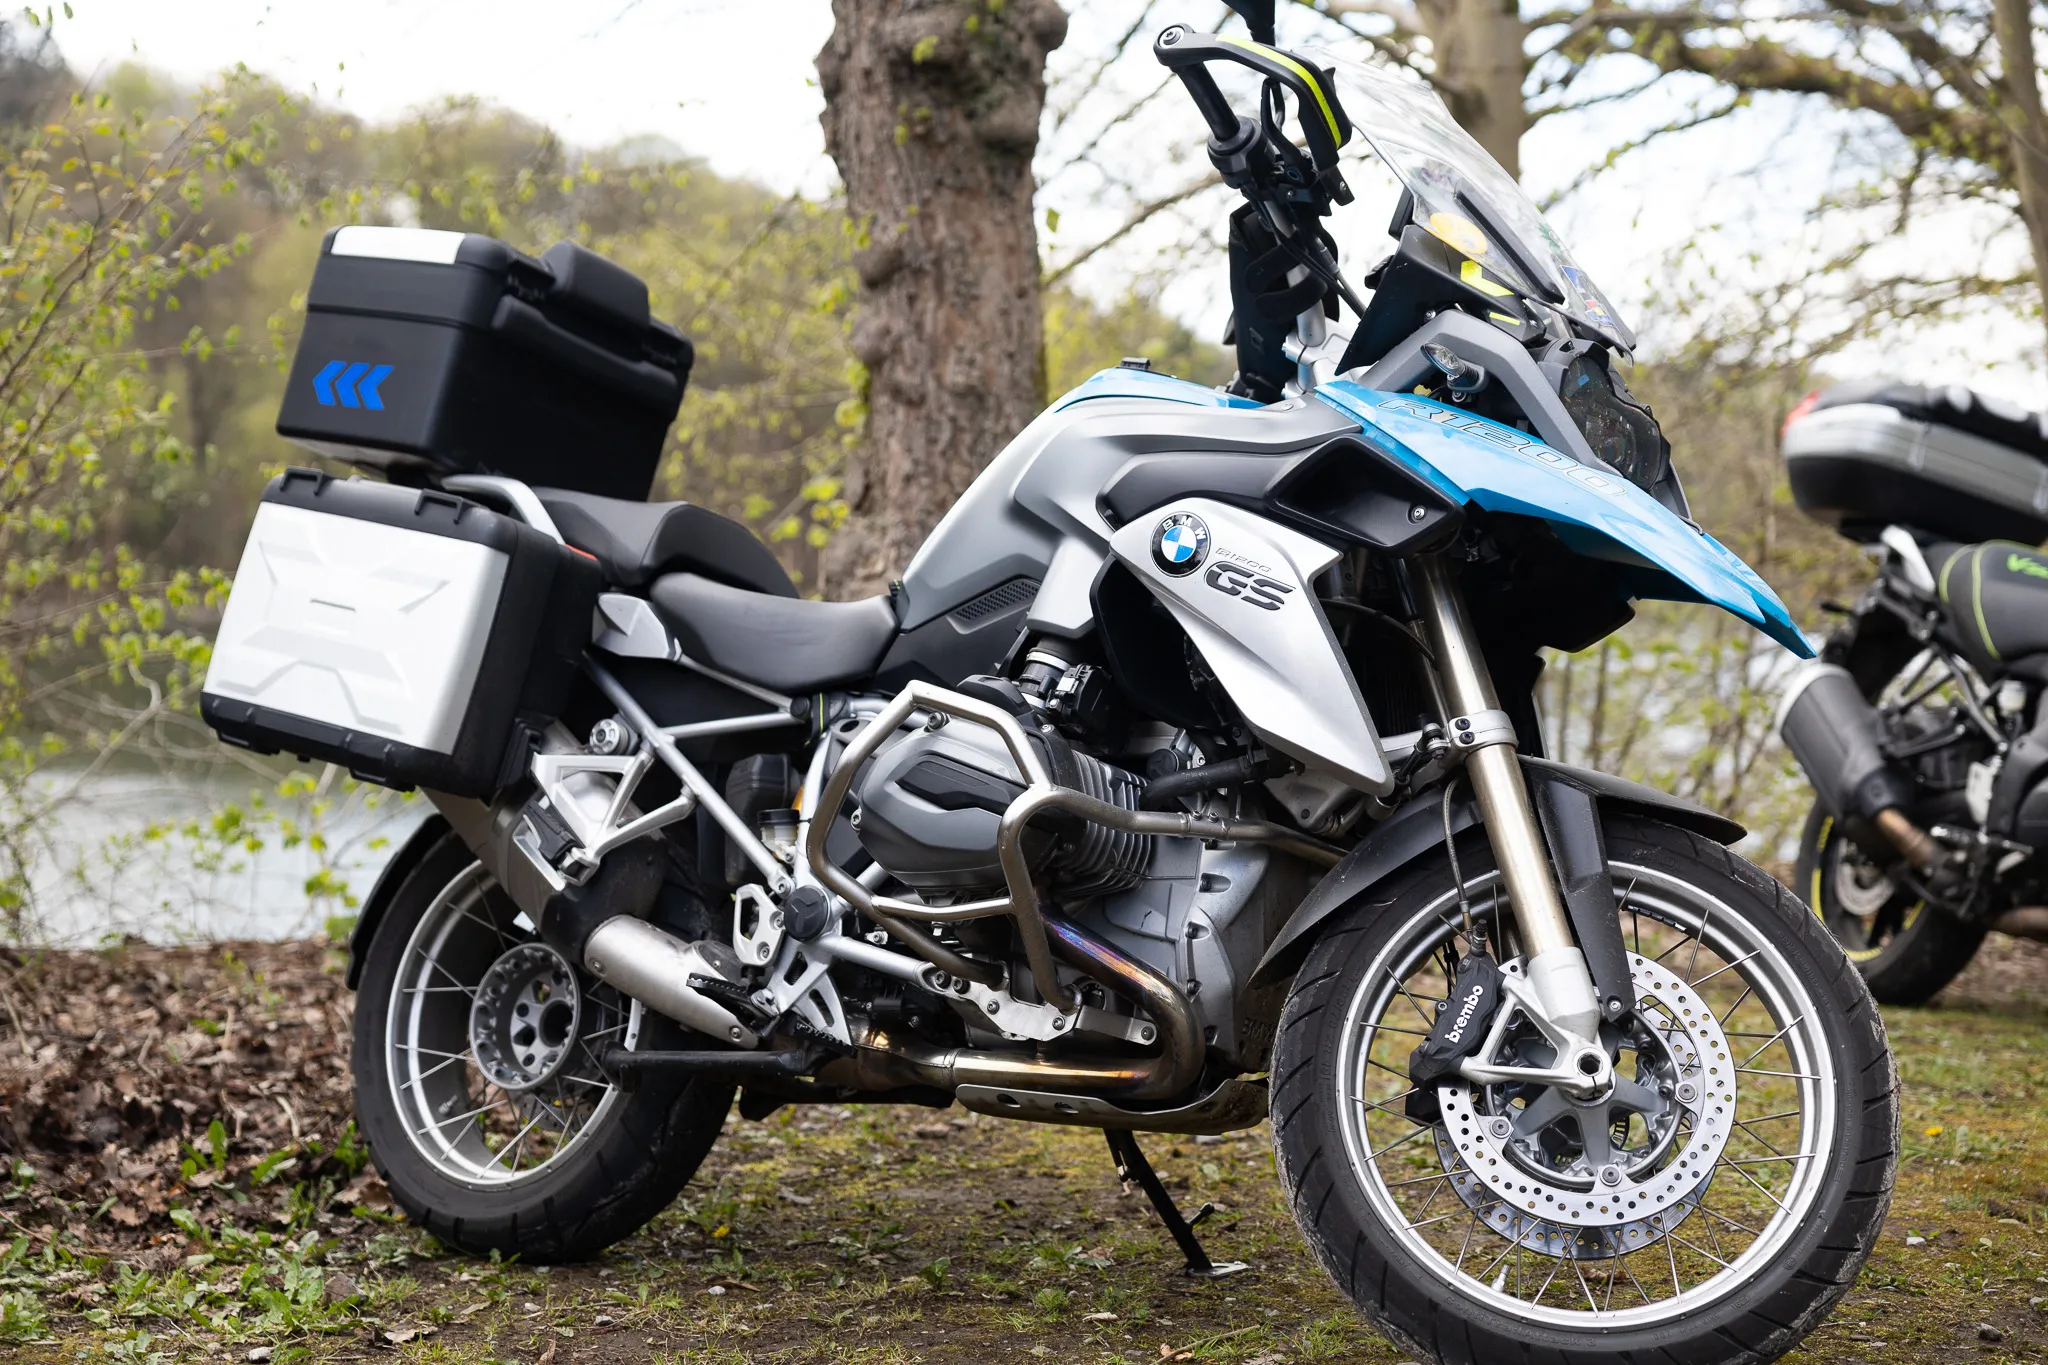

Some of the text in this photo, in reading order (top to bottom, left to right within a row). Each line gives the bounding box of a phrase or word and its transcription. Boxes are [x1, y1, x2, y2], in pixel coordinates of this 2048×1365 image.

[1377, 398, 1627, 497] R1200
[1161, 513, 1208, 540] BMW
[1215, 547, 1272, 572] R1200
[1205, 562, 1294, 611] GS
[1444, 985, 1484, 1044] brembo
